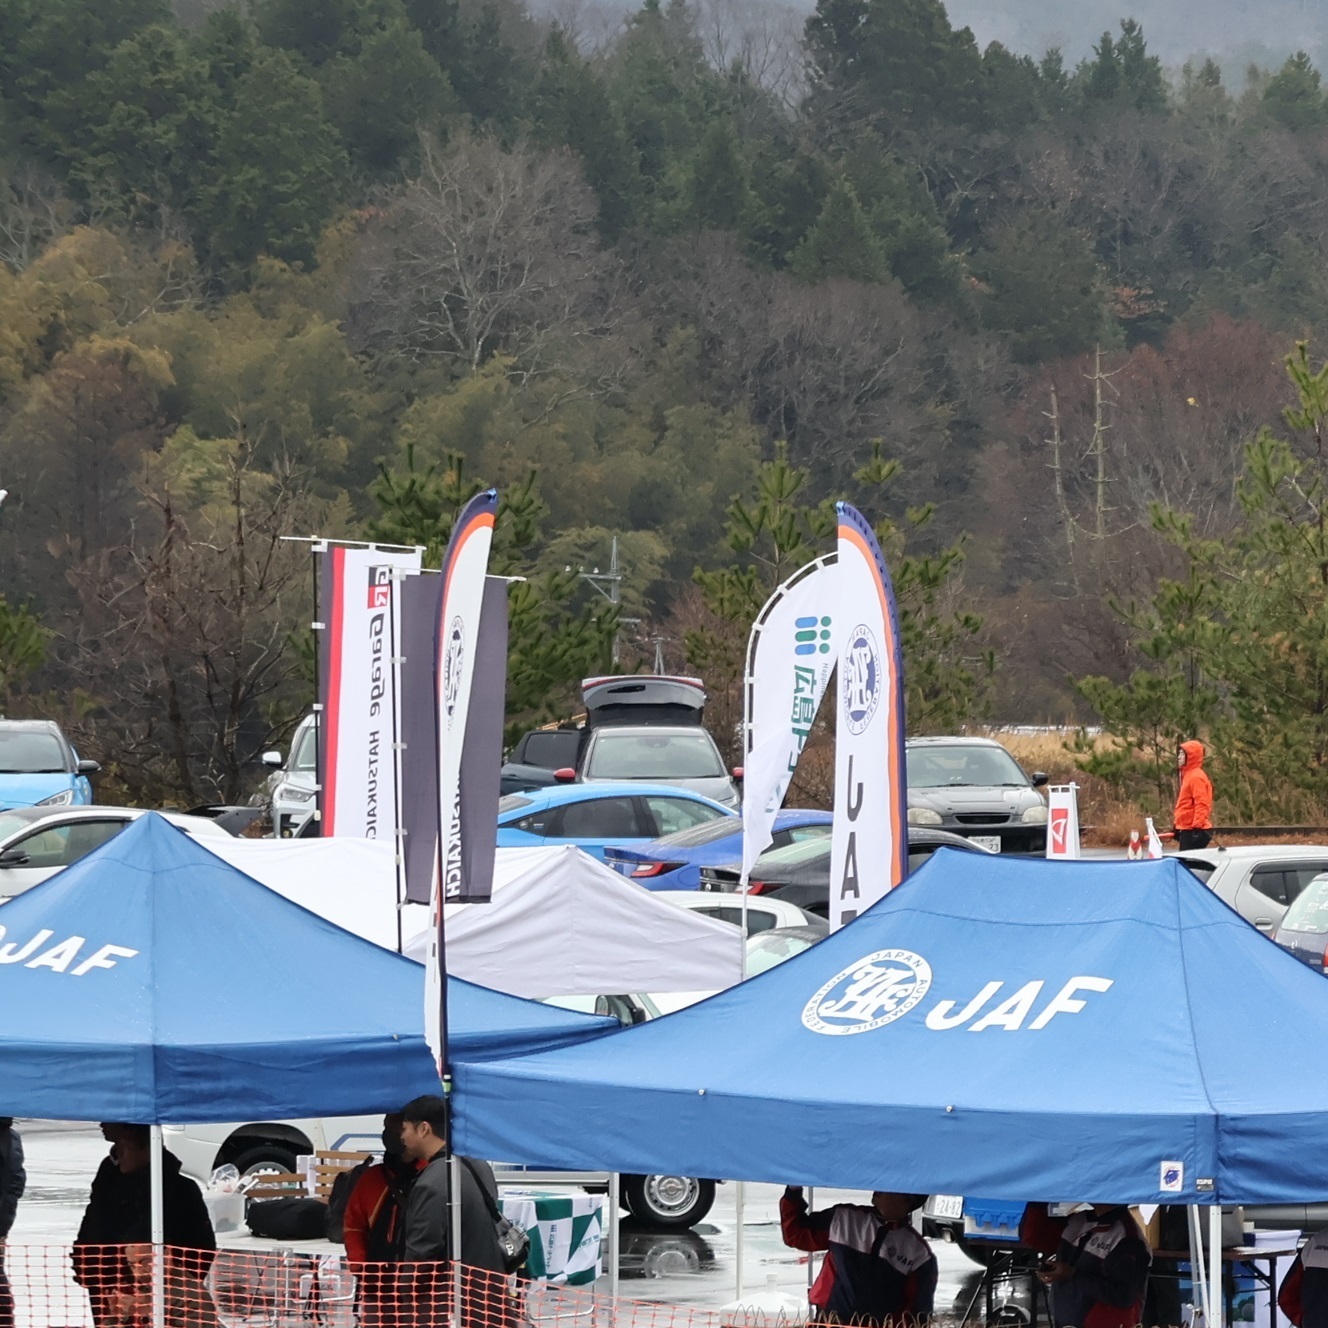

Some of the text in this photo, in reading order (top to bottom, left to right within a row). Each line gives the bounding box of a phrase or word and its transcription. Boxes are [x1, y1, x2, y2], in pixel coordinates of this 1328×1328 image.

[0, 929, 140, 976] JAF
[805, 951, 928, 1034] JAPAN AUTOMOBILE FEDERATION
[925, 975, 1115, 1031] JAF
